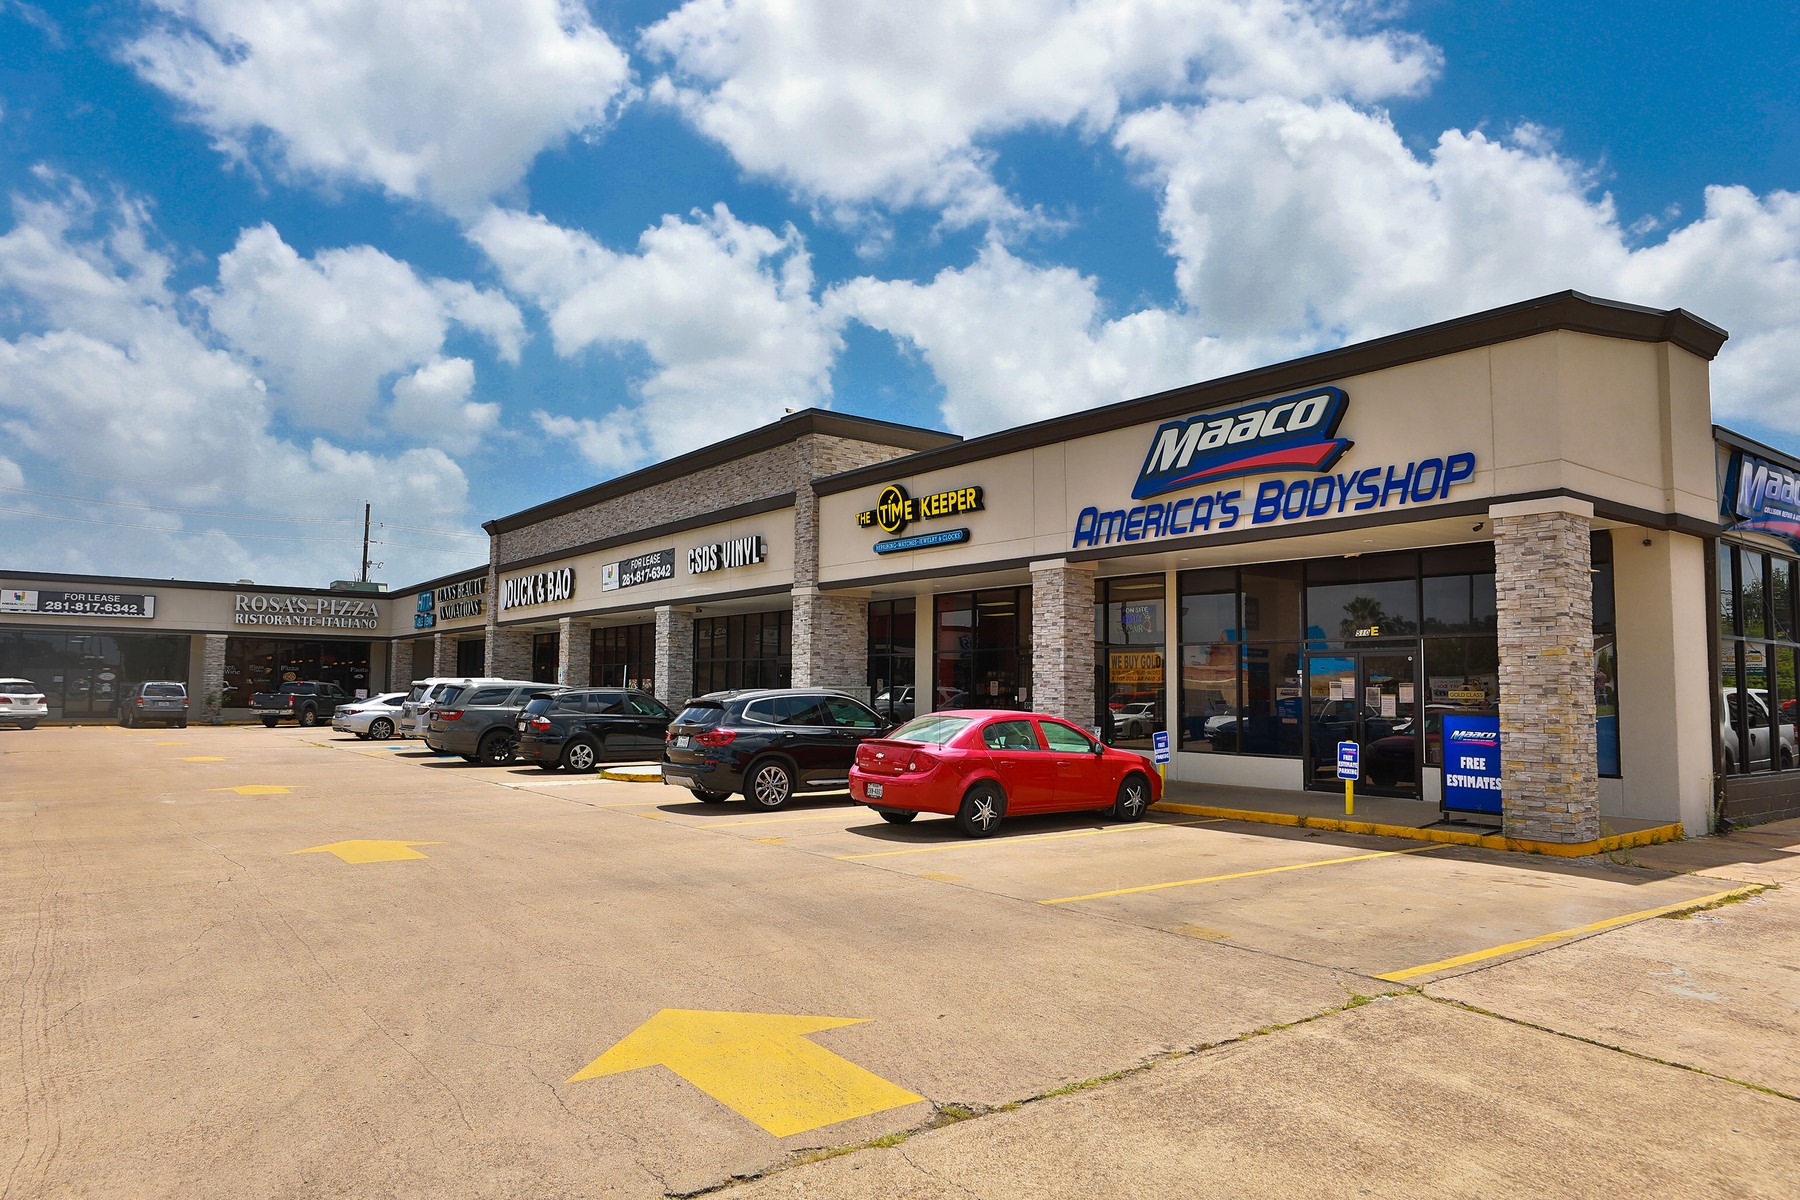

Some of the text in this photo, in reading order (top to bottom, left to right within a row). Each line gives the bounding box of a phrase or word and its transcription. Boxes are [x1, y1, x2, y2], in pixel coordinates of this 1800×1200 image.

[1146, 395, 1330, 476] Maaco
[855, 487, 977, 525] THE TIME KEEPER
[1072, 452, 1475, 548] AMERICA'S BODYSHOP
[631, 553, 660, 569] FOR LEASE
[688, 536, 760, 574] CSDS VINYL
[622, 564, 671, 586] 281-817-6342
[507, 568, 571, 608] DUCK & BAO
[64, 593, 121, 602] FOR LEASE
[235, 595, 379, 617] ROSA'S PIZZA
[45, 601, 138, 613] 281-817-6342
[235, 613, 377, 629] RISTORANTE ITALIANO
[1111, 654, 1162, 668] WE BUY GOLD
[1450, 730, 1497, 740] Maaco
[1460, 756, 1486, 770] FREE
[1446, 773, 1502, 791] ESTIMATES
